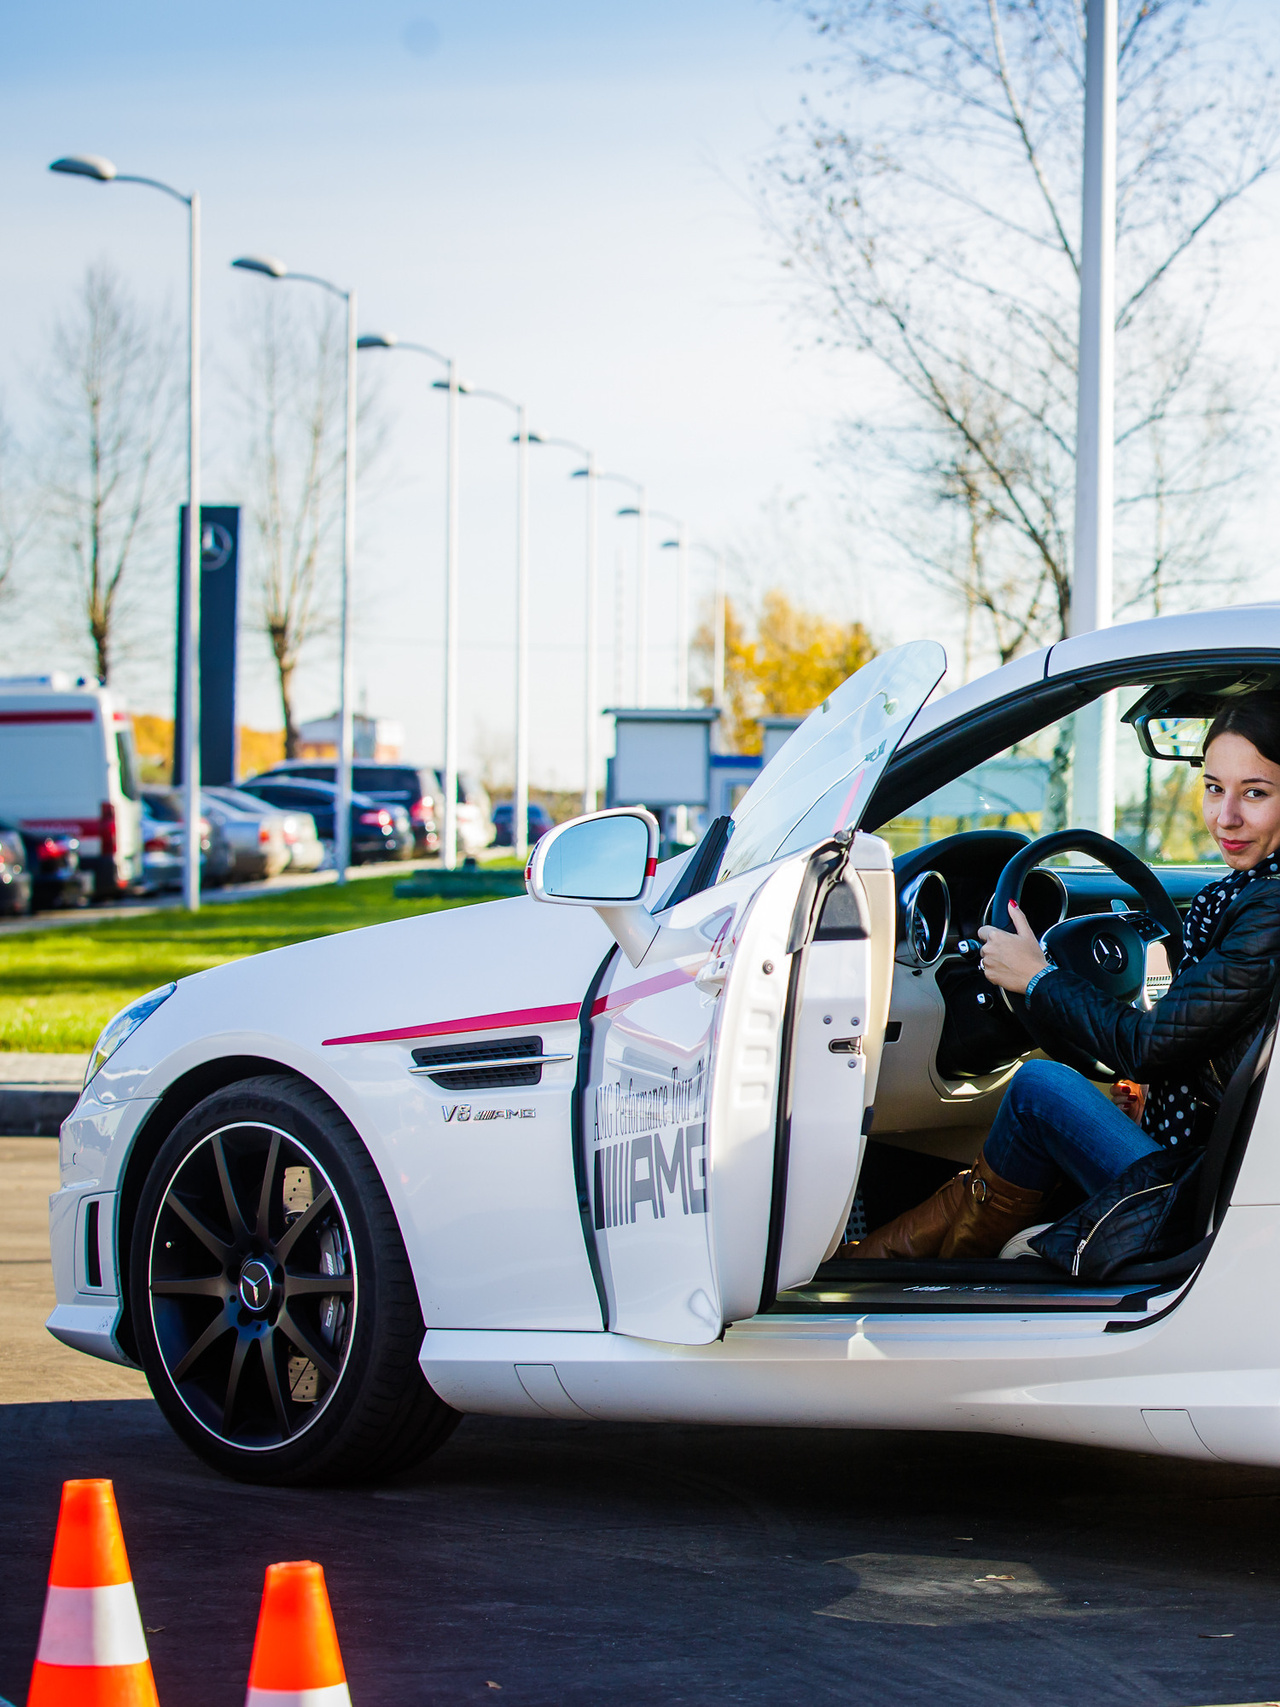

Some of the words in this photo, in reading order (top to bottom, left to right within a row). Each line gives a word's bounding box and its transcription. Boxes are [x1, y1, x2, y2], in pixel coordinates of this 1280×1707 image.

[216, 1097, 279, 1115] ZERO
[441, 1104, 472, 1122] V8
[493, 1108, 536, 1120] AMG
[594, 1083, 613, 1141] AMG
[615, 1078, 668, 1136] Performance
[672, 1066, 693, 1124] Tour
[630, 1122, 708, 1223] AMG
